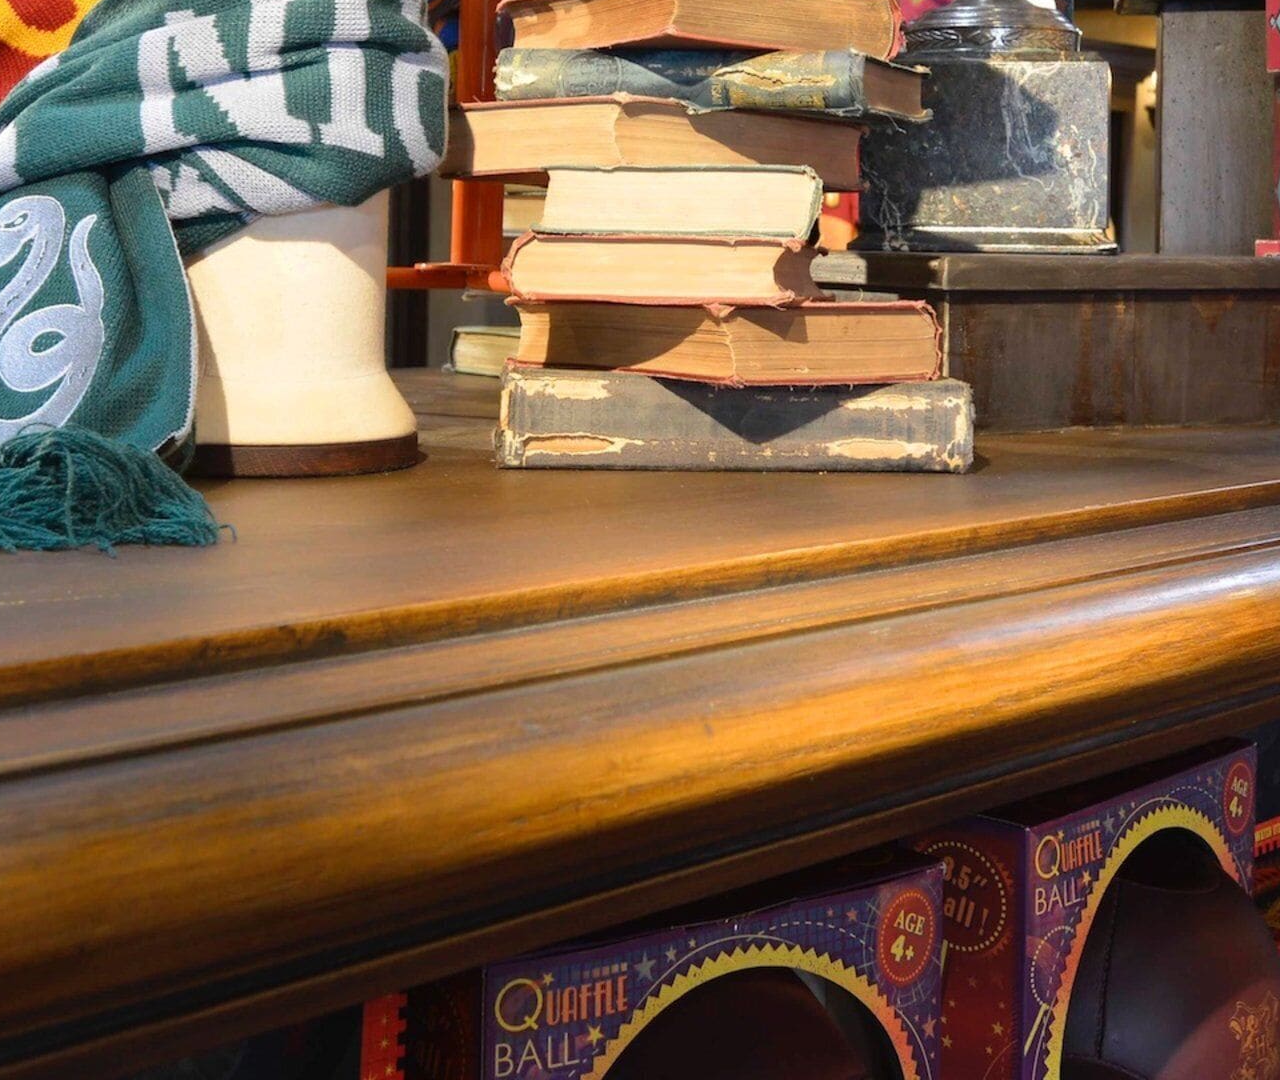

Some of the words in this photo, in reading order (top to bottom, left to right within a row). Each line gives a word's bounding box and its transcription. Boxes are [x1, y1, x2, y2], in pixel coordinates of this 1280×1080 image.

[1229, 775, 1249, 797] AGE
[1228, 795, 1244, 818] 4+
[1035, 830, 1104, 880] QUAFFLE
[1035, 875, 1082, 916] BALL
[894, 909, 925, 936] AGE
[890, 935, 915, 963] 4+
[494, 974, 629, 1033] QUAFFLE
[494, 1032, 580, 1078] BALL
